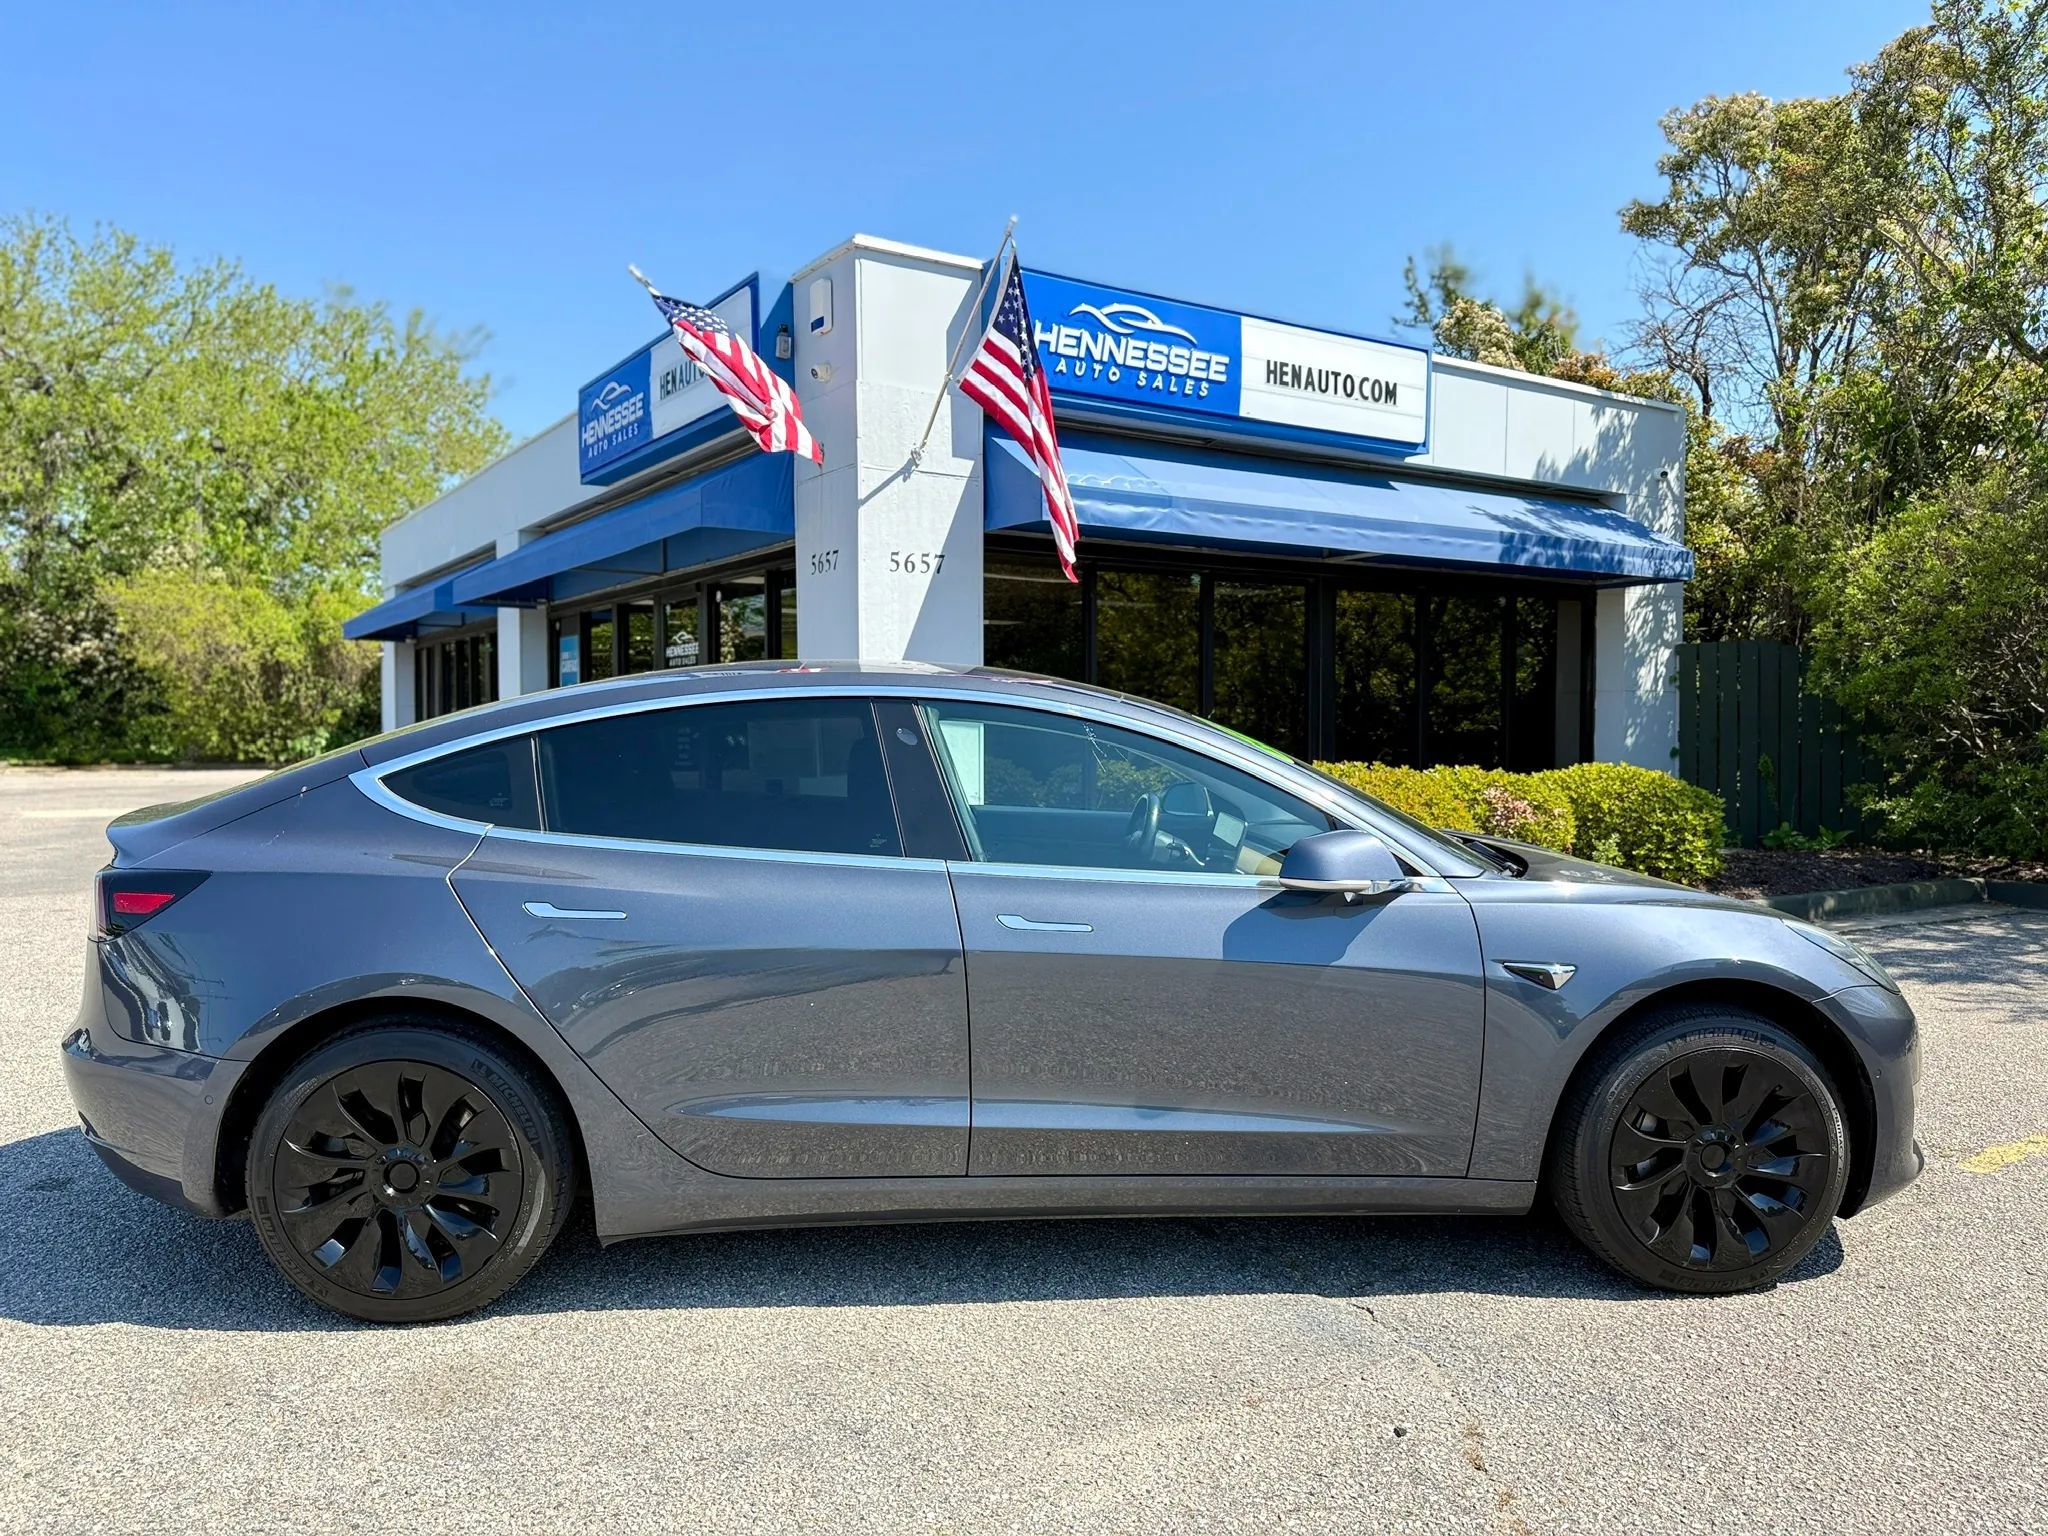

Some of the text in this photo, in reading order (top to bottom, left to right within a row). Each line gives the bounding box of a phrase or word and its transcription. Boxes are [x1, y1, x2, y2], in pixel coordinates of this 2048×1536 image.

[1034, 319, 1230, 382] HENNESSEE
[1055, 357, 1209, 397] AUTO SALES
[1266, 359, 1397, 405] HENAUTO.COM
[581, 392, 644, 448] HENNESSEE
[588, 422, 639, 459] AUTO SALES
[811, 550, 839, 575] 5657
[889, 551, 945, 574] 5657
[488, 1072, 540, 1142] MICHELIN
